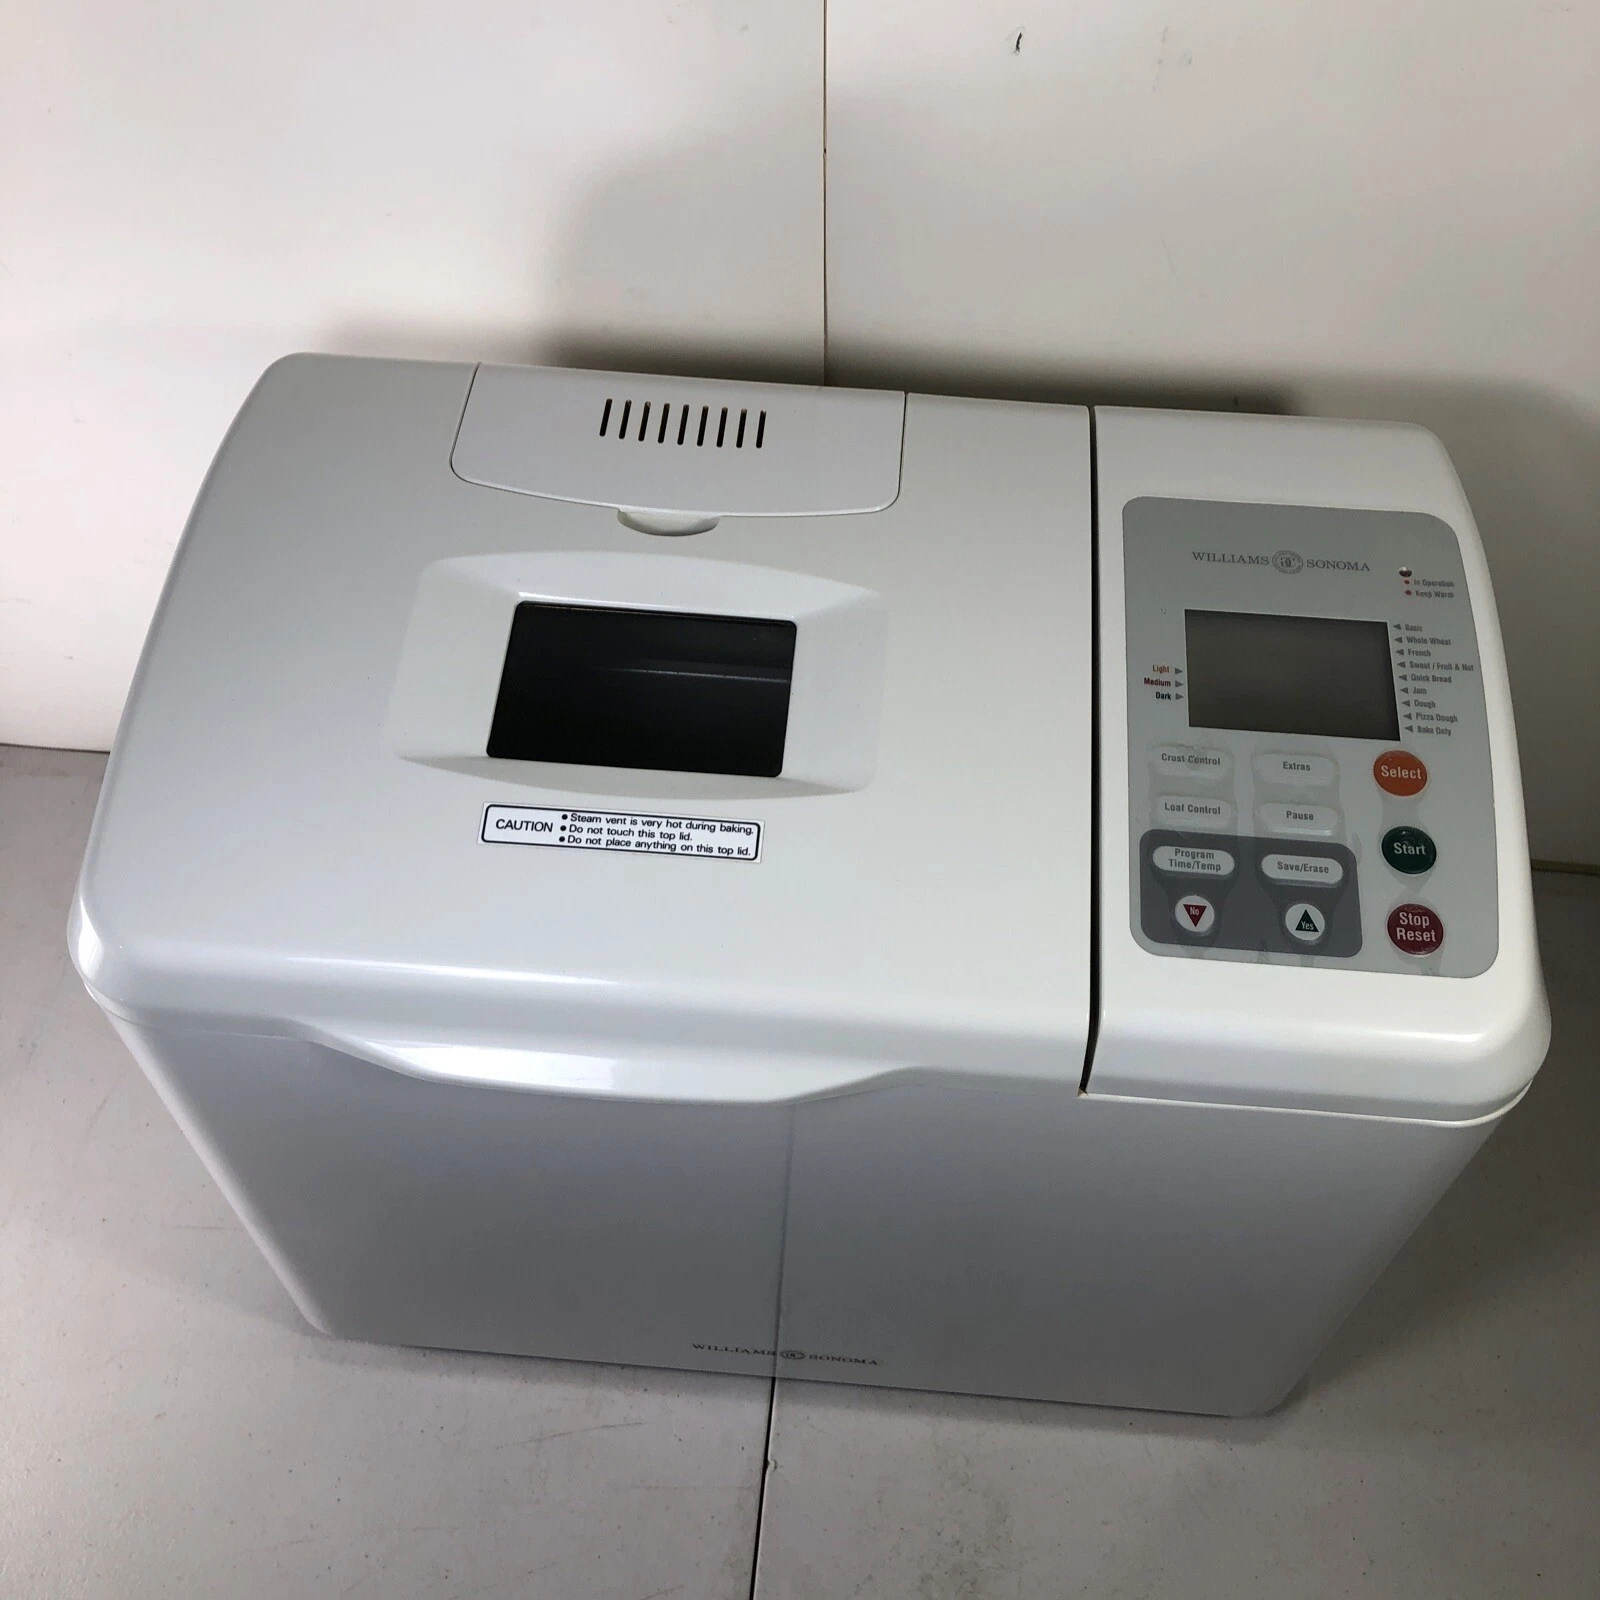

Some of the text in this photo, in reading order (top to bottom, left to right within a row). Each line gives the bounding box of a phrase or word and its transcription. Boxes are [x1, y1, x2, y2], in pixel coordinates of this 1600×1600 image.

[1191, 551, 1270, 566] WILLIAMS
[1306, 558, 1371, 572] SONOMA
[1422, 578, 1455, 588] Operation
[1415, 590, 1454, 599] Keep Warm
[1404, 623, 1423, 632] Basic
[1406, 636, 1451, 645] Whole Wheat
[1407, 648, 1432, 657] French
[1152, 663, 1170, 674] Light
[1409, 660, 1431, 669] Sweet
[1436, 662, 1453, 670] Fruit
[1461, 663, 1474, 671] Nut
[1143, 677, 1171, 688] Medium
[1410, 673, 1452, 683] Quick Bread
[1155, 691, 1171, 701] Dark
[1412, 686, 1427, 695] Jam
[1414, 699, 1436, 709] Dough
[1415, 712, 1458, 723] Pizza Dough
[1417, 725, 1452, 736] Bake Only
[1160, 752, 1221, 766] Crust Control
[1282, 760, 1311, 772] Extras
[1380, 765, 1422, 780] Select
[1164, 802, 1221, 815] Loaf Control
[1286, 810, 1314, 821] Pause
[495, 818, 554, 833] CAUTION
[570, 812, 754, 836] Steam vent is very hot during baking.
[569, 824, 693, 842] Do not touch this top lid.
[567, 834, 751, 857] Do not place anything on this top lid.
[1393, 842, 1426, 856] Start
[1174, 848, 1215, 862] Program
[1168, 858, 1222, 873] Time/Temp
[1277, 860, 1330, 875] Save/Erase
[1189, 906, 1200, 917] No
[1300, 920, 1315, 931] Yes
[1399, 911, 1430, 929] Stop
[1396, 926, 1437, 943] Reset
[692, 1342, 777, 1356] WILLIAMS
[808, 1354, 878, 1366] SONOMA
